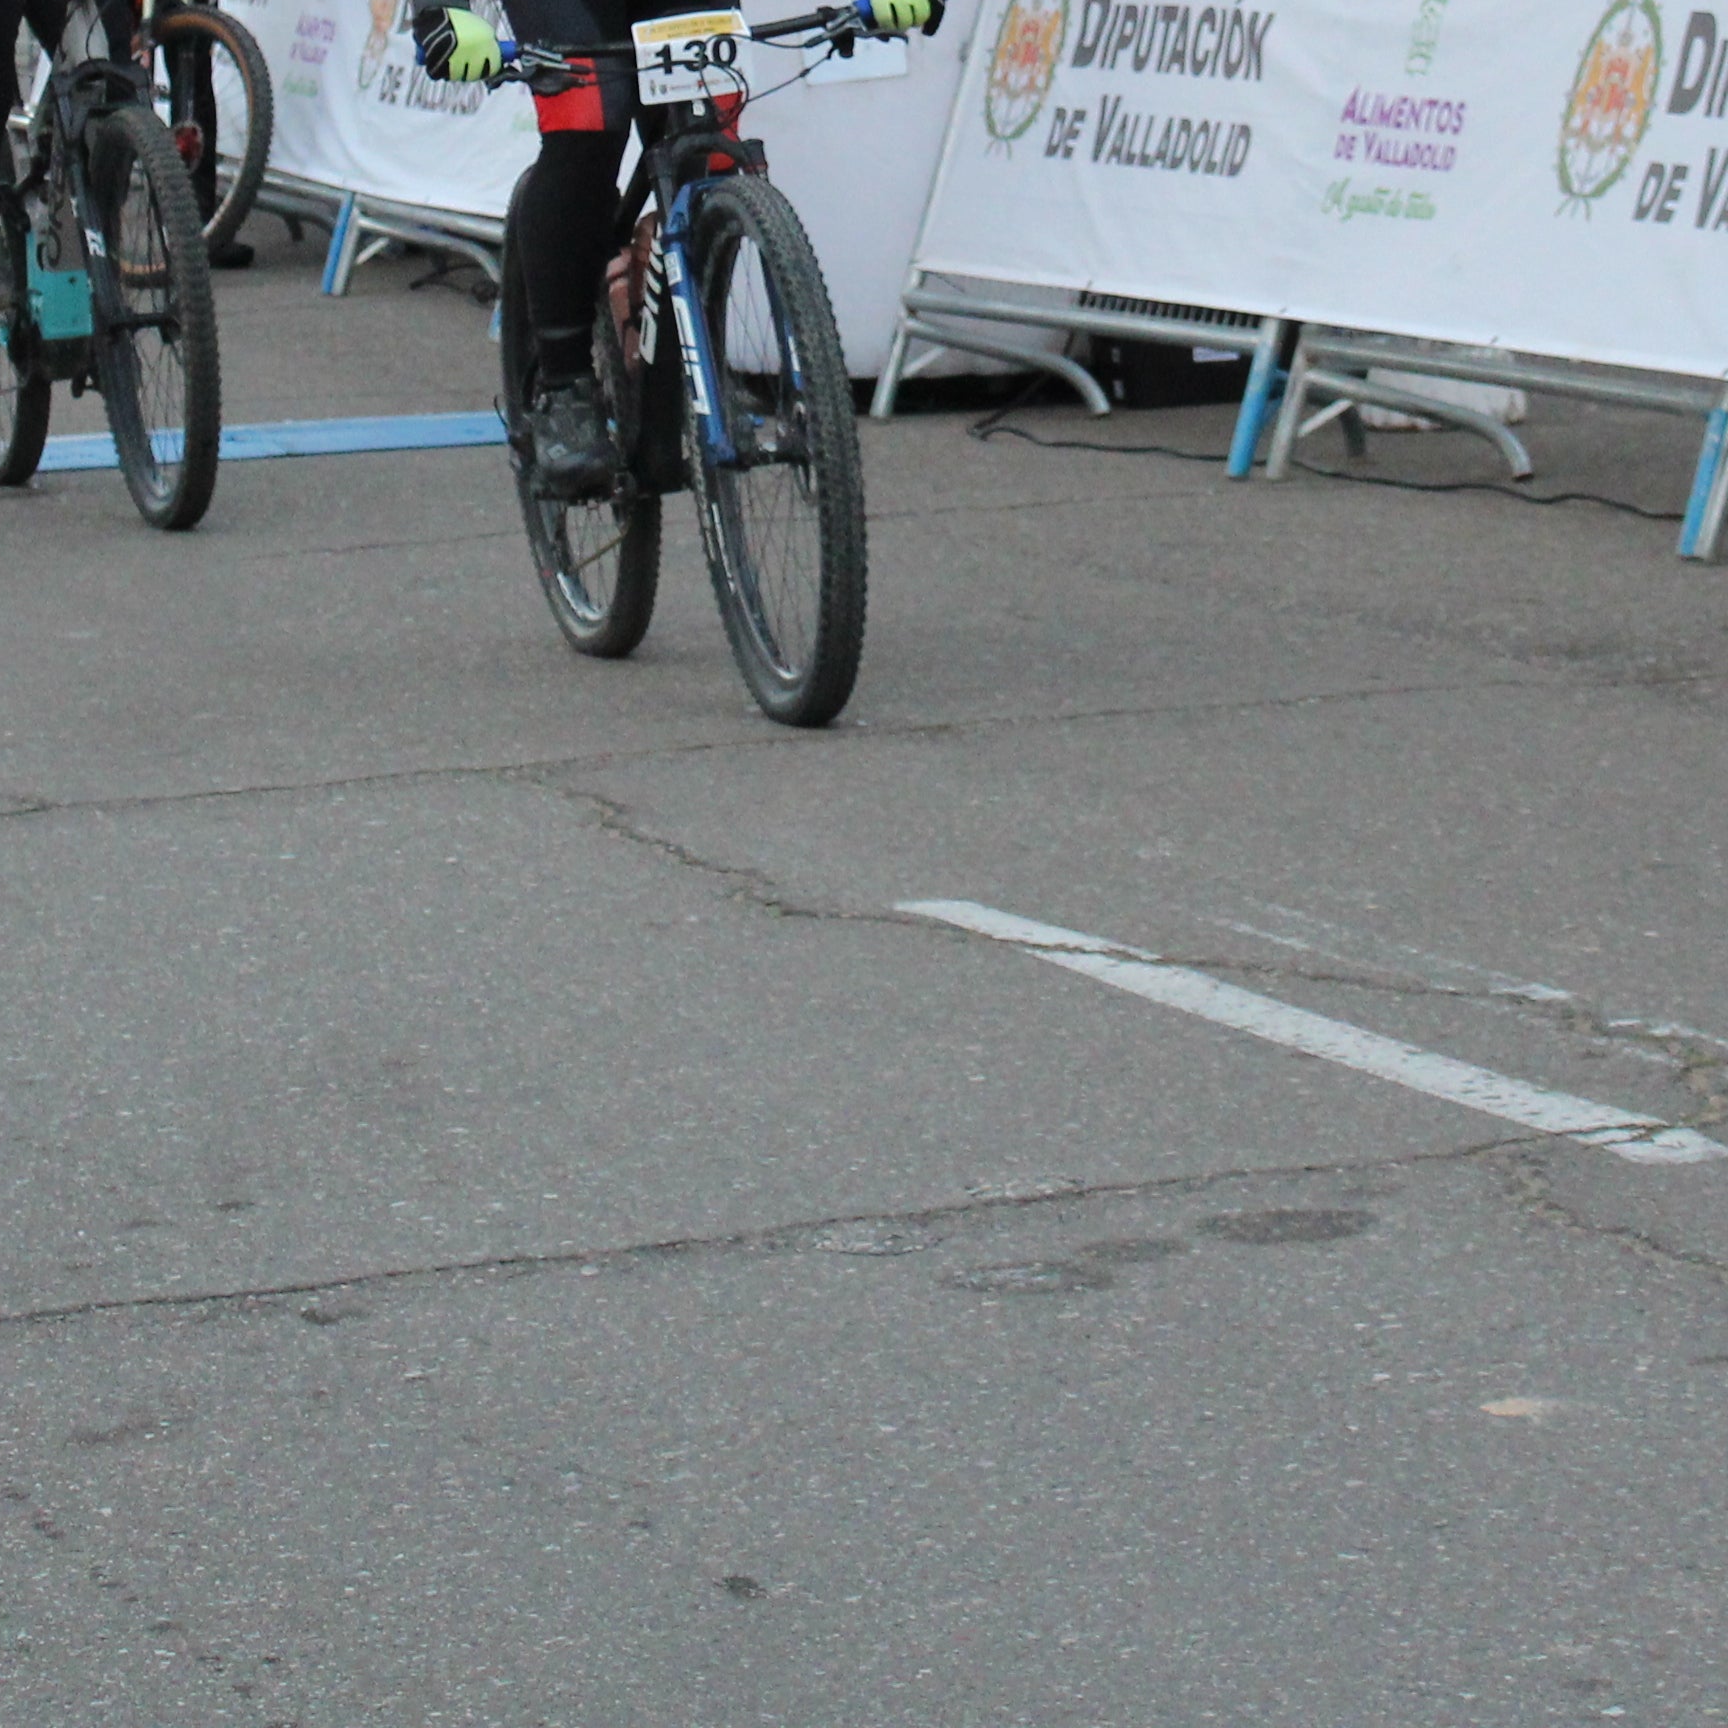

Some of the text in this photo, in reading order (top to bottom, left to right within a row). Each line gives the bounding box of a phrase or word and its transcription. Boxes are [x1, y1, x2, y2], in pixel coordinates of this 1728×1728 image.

[655, 36, 737, 75] 130
[1044, 94, 1252, 177] DE VALLADOLID
[1340, 84, 1466, 136] ALIMENTOS
[1633, 161, 1688, 223] DE
